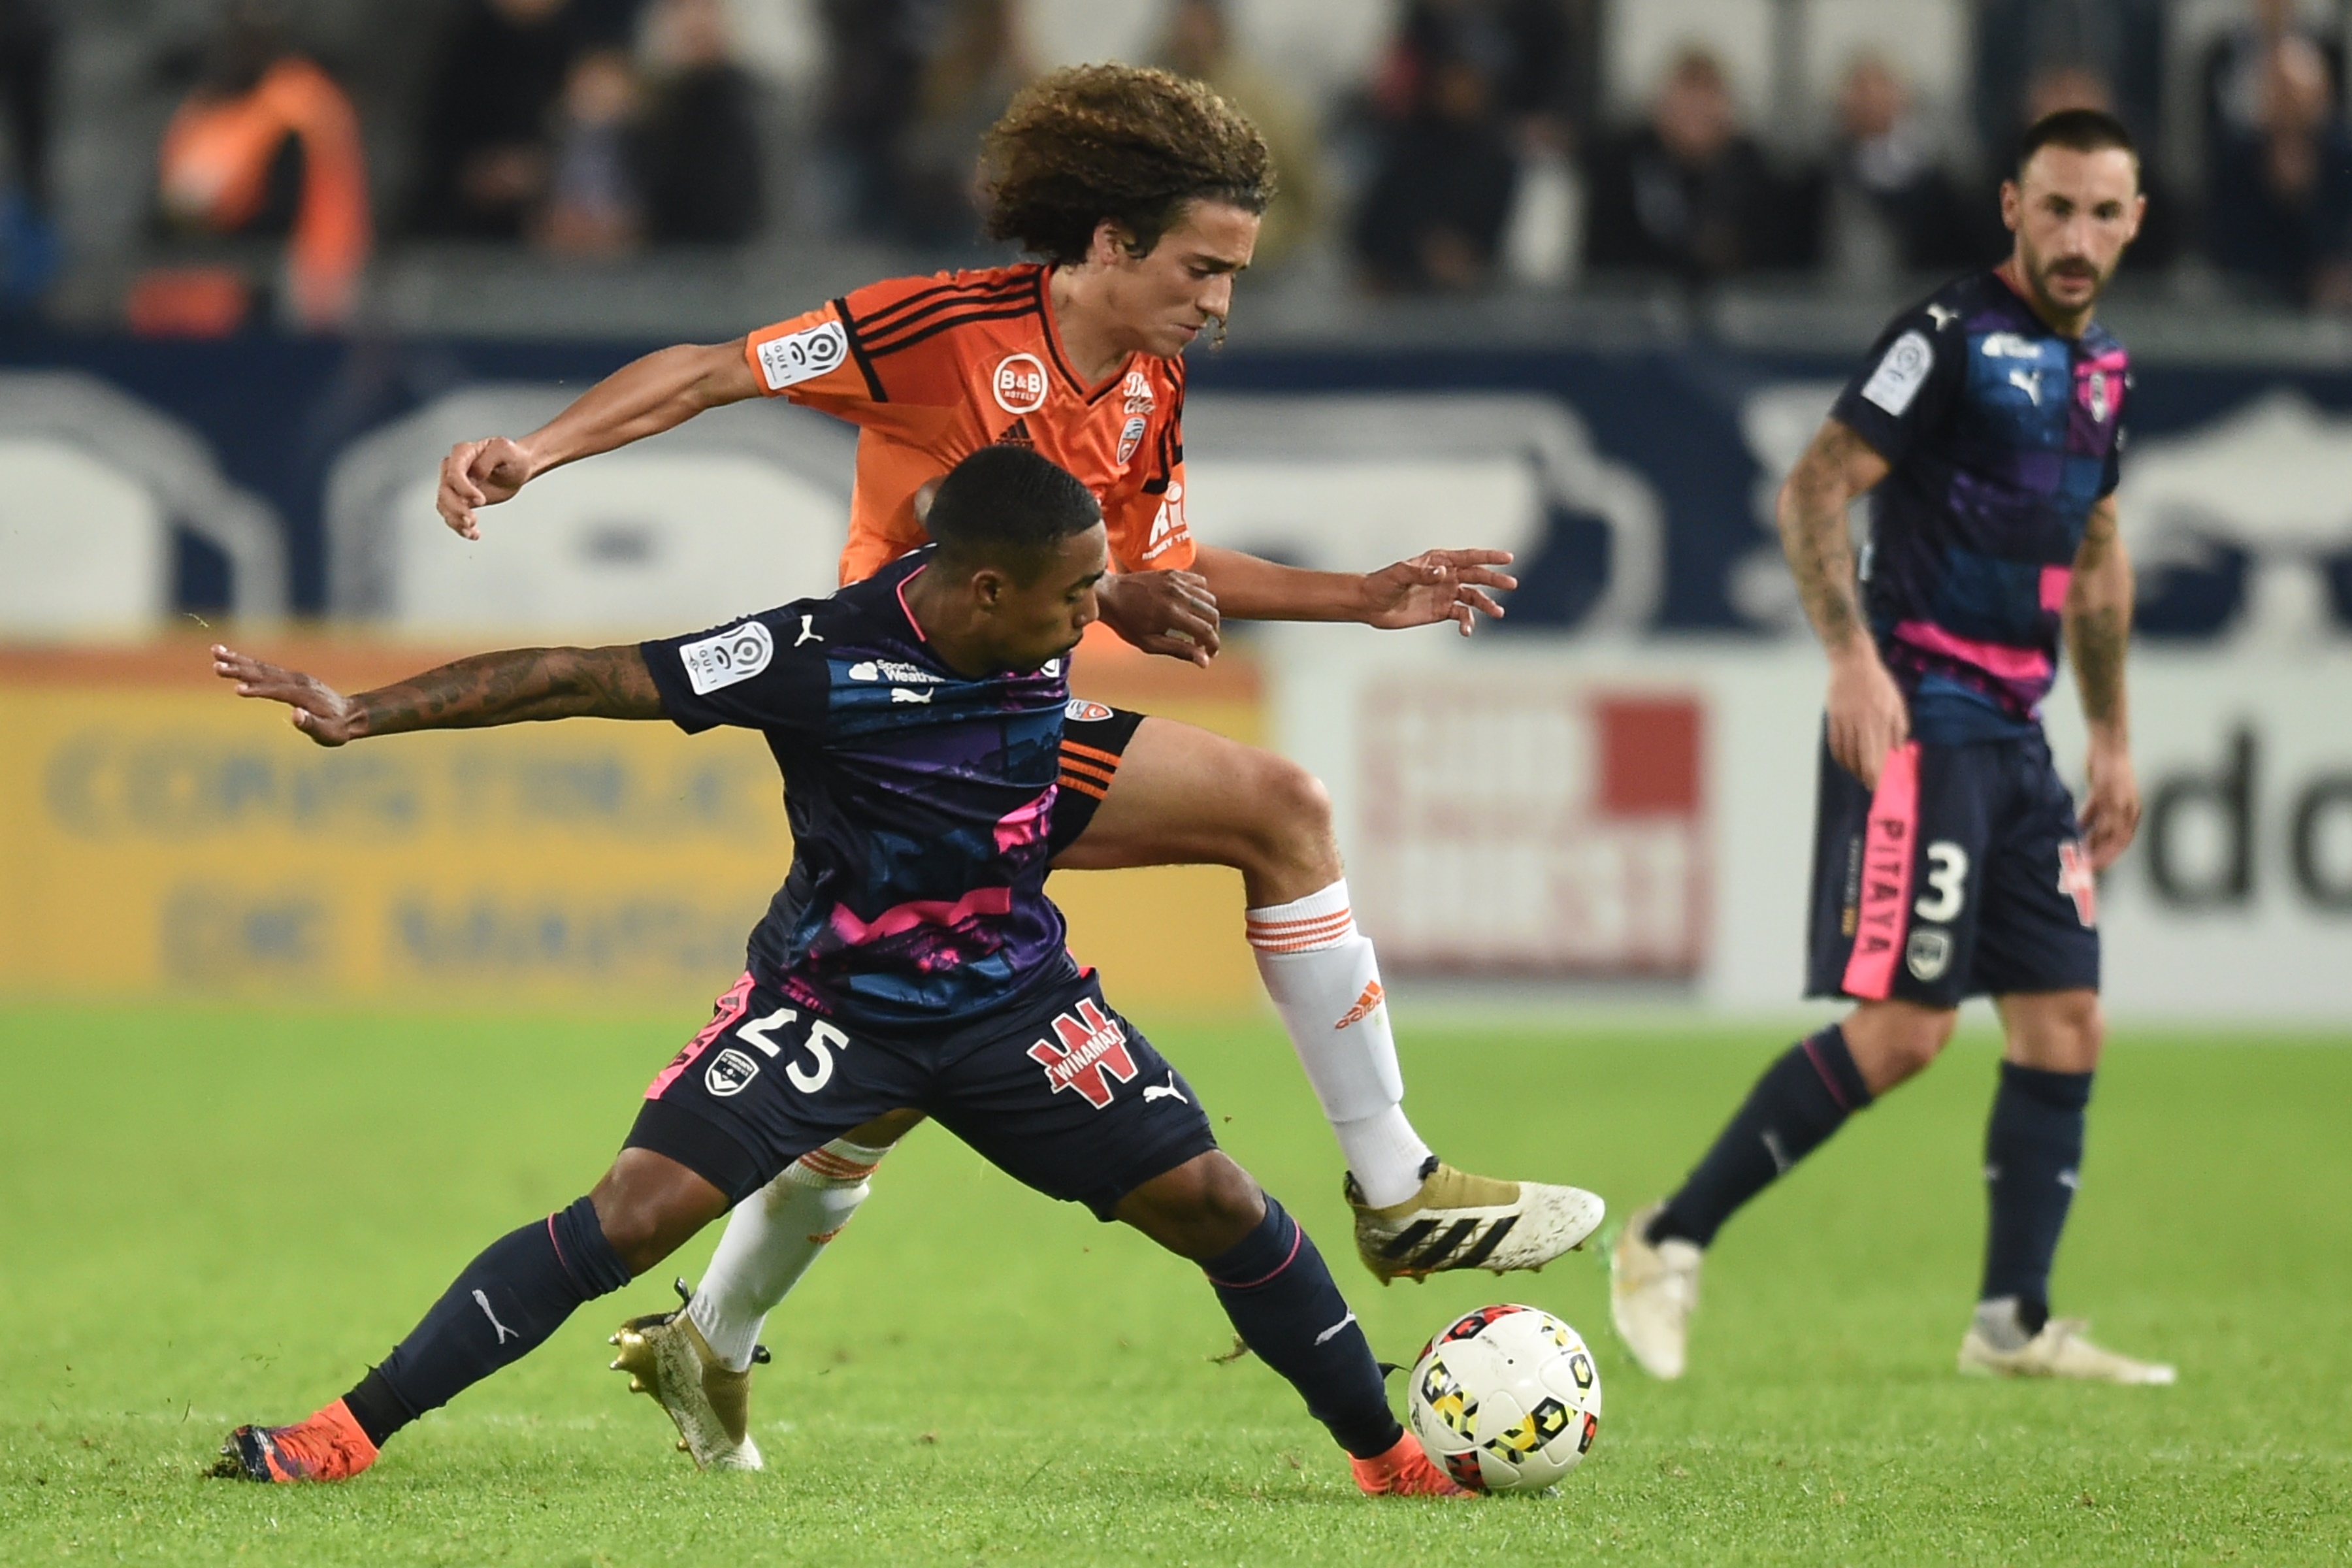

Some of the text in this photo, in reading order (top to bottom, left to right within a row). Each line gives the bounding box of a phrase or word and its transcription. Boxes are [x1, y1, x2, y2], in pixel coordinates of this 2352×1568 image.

[1000, 369, 1041, 393] B&B
[876, 659, 918, 672] Sports
[1863, 819, 1905, 954] PITAYA
[1914, 840, 1968, 922] 3
[736, 1007, 849, 1094] 25
[1053, 1026, 1120, 1081] WINAMAX
